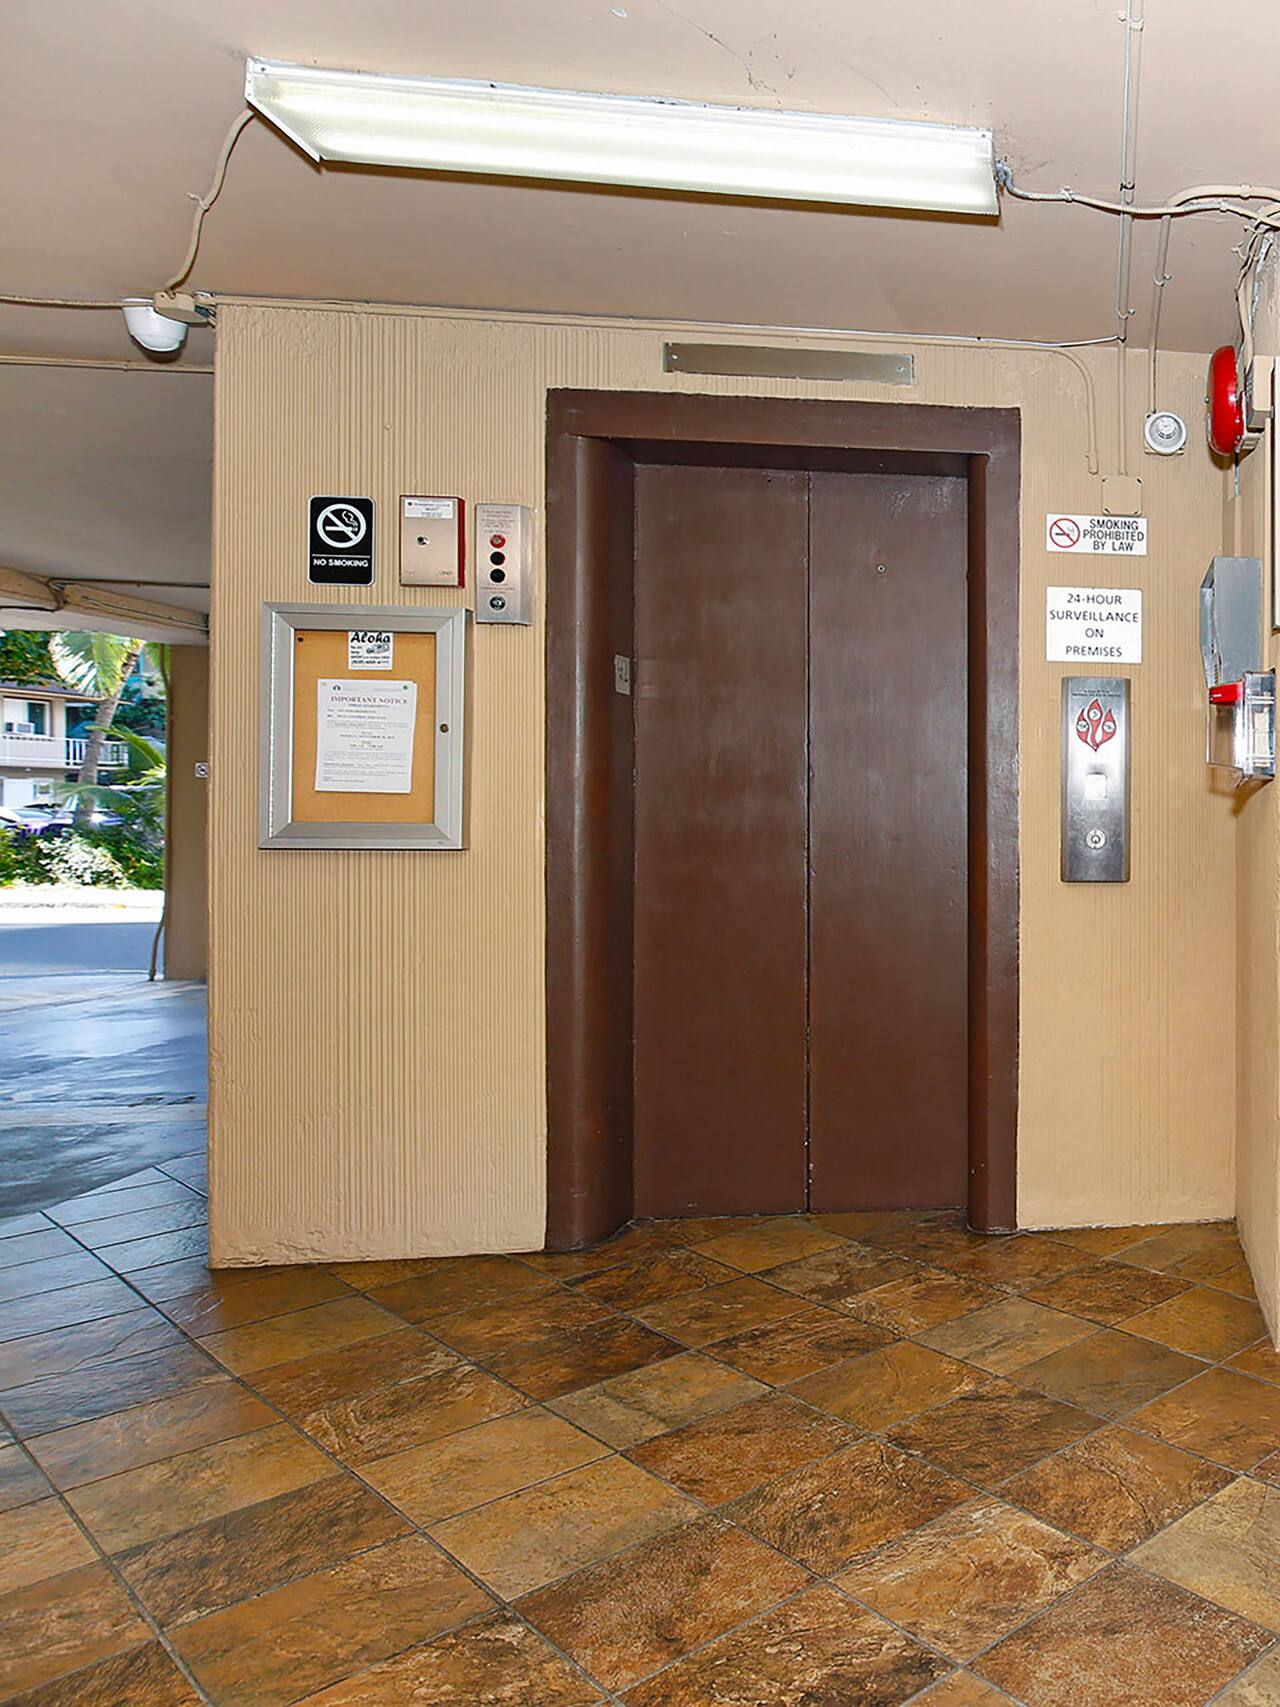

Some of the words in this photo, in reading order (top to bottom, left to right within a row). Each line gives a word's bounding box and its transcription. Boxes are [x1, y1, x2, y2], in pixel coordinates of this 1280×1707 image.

[1090, 518, 1138, 530] SMOKING
[1083, 530, 1144, 542] PROHIBITED
[1093, 540, 1106, 550] BY
[1112, 542, 1134, 552] LAW
[313, 558, 327, 566] NO
[328, 559, 368, 567] SMOKING
[1067, 593, 1122, 605] 24-HOUR
[1050, 610, 1138, 623] SURVEILLANCE
[350, 631, 390, 643] Aloha
[1085, 628, 1104, 638] ON
[1066, 646, 1122, 657] PREMISES
[331, 696, 377, 704] IMPORTANT
